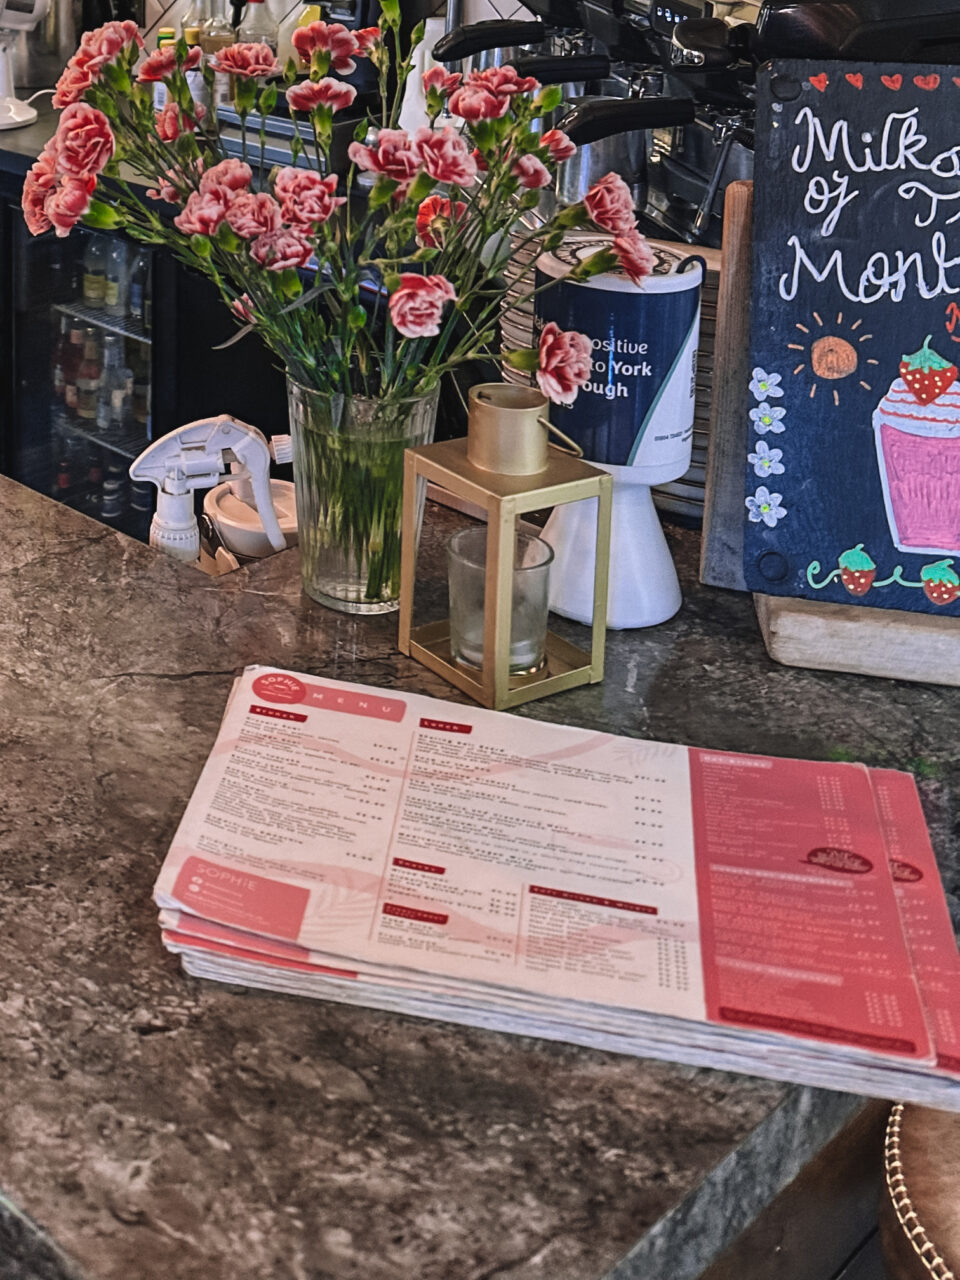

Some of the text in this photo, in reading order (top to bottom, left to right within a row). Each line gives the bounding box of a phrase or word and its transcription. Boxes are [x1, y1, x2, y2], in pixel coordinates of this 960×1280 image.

[804, 170, 859, 236] of
[591, 338, 648, 355] ositive
[613, 361, 652, 376] York
[582, 381, 629, 400] ough
[261, 677, 300, 691] SOPHIE
[312, 693, 392, 713] MENU
[196, 864, 258, 891] SOPHIE
